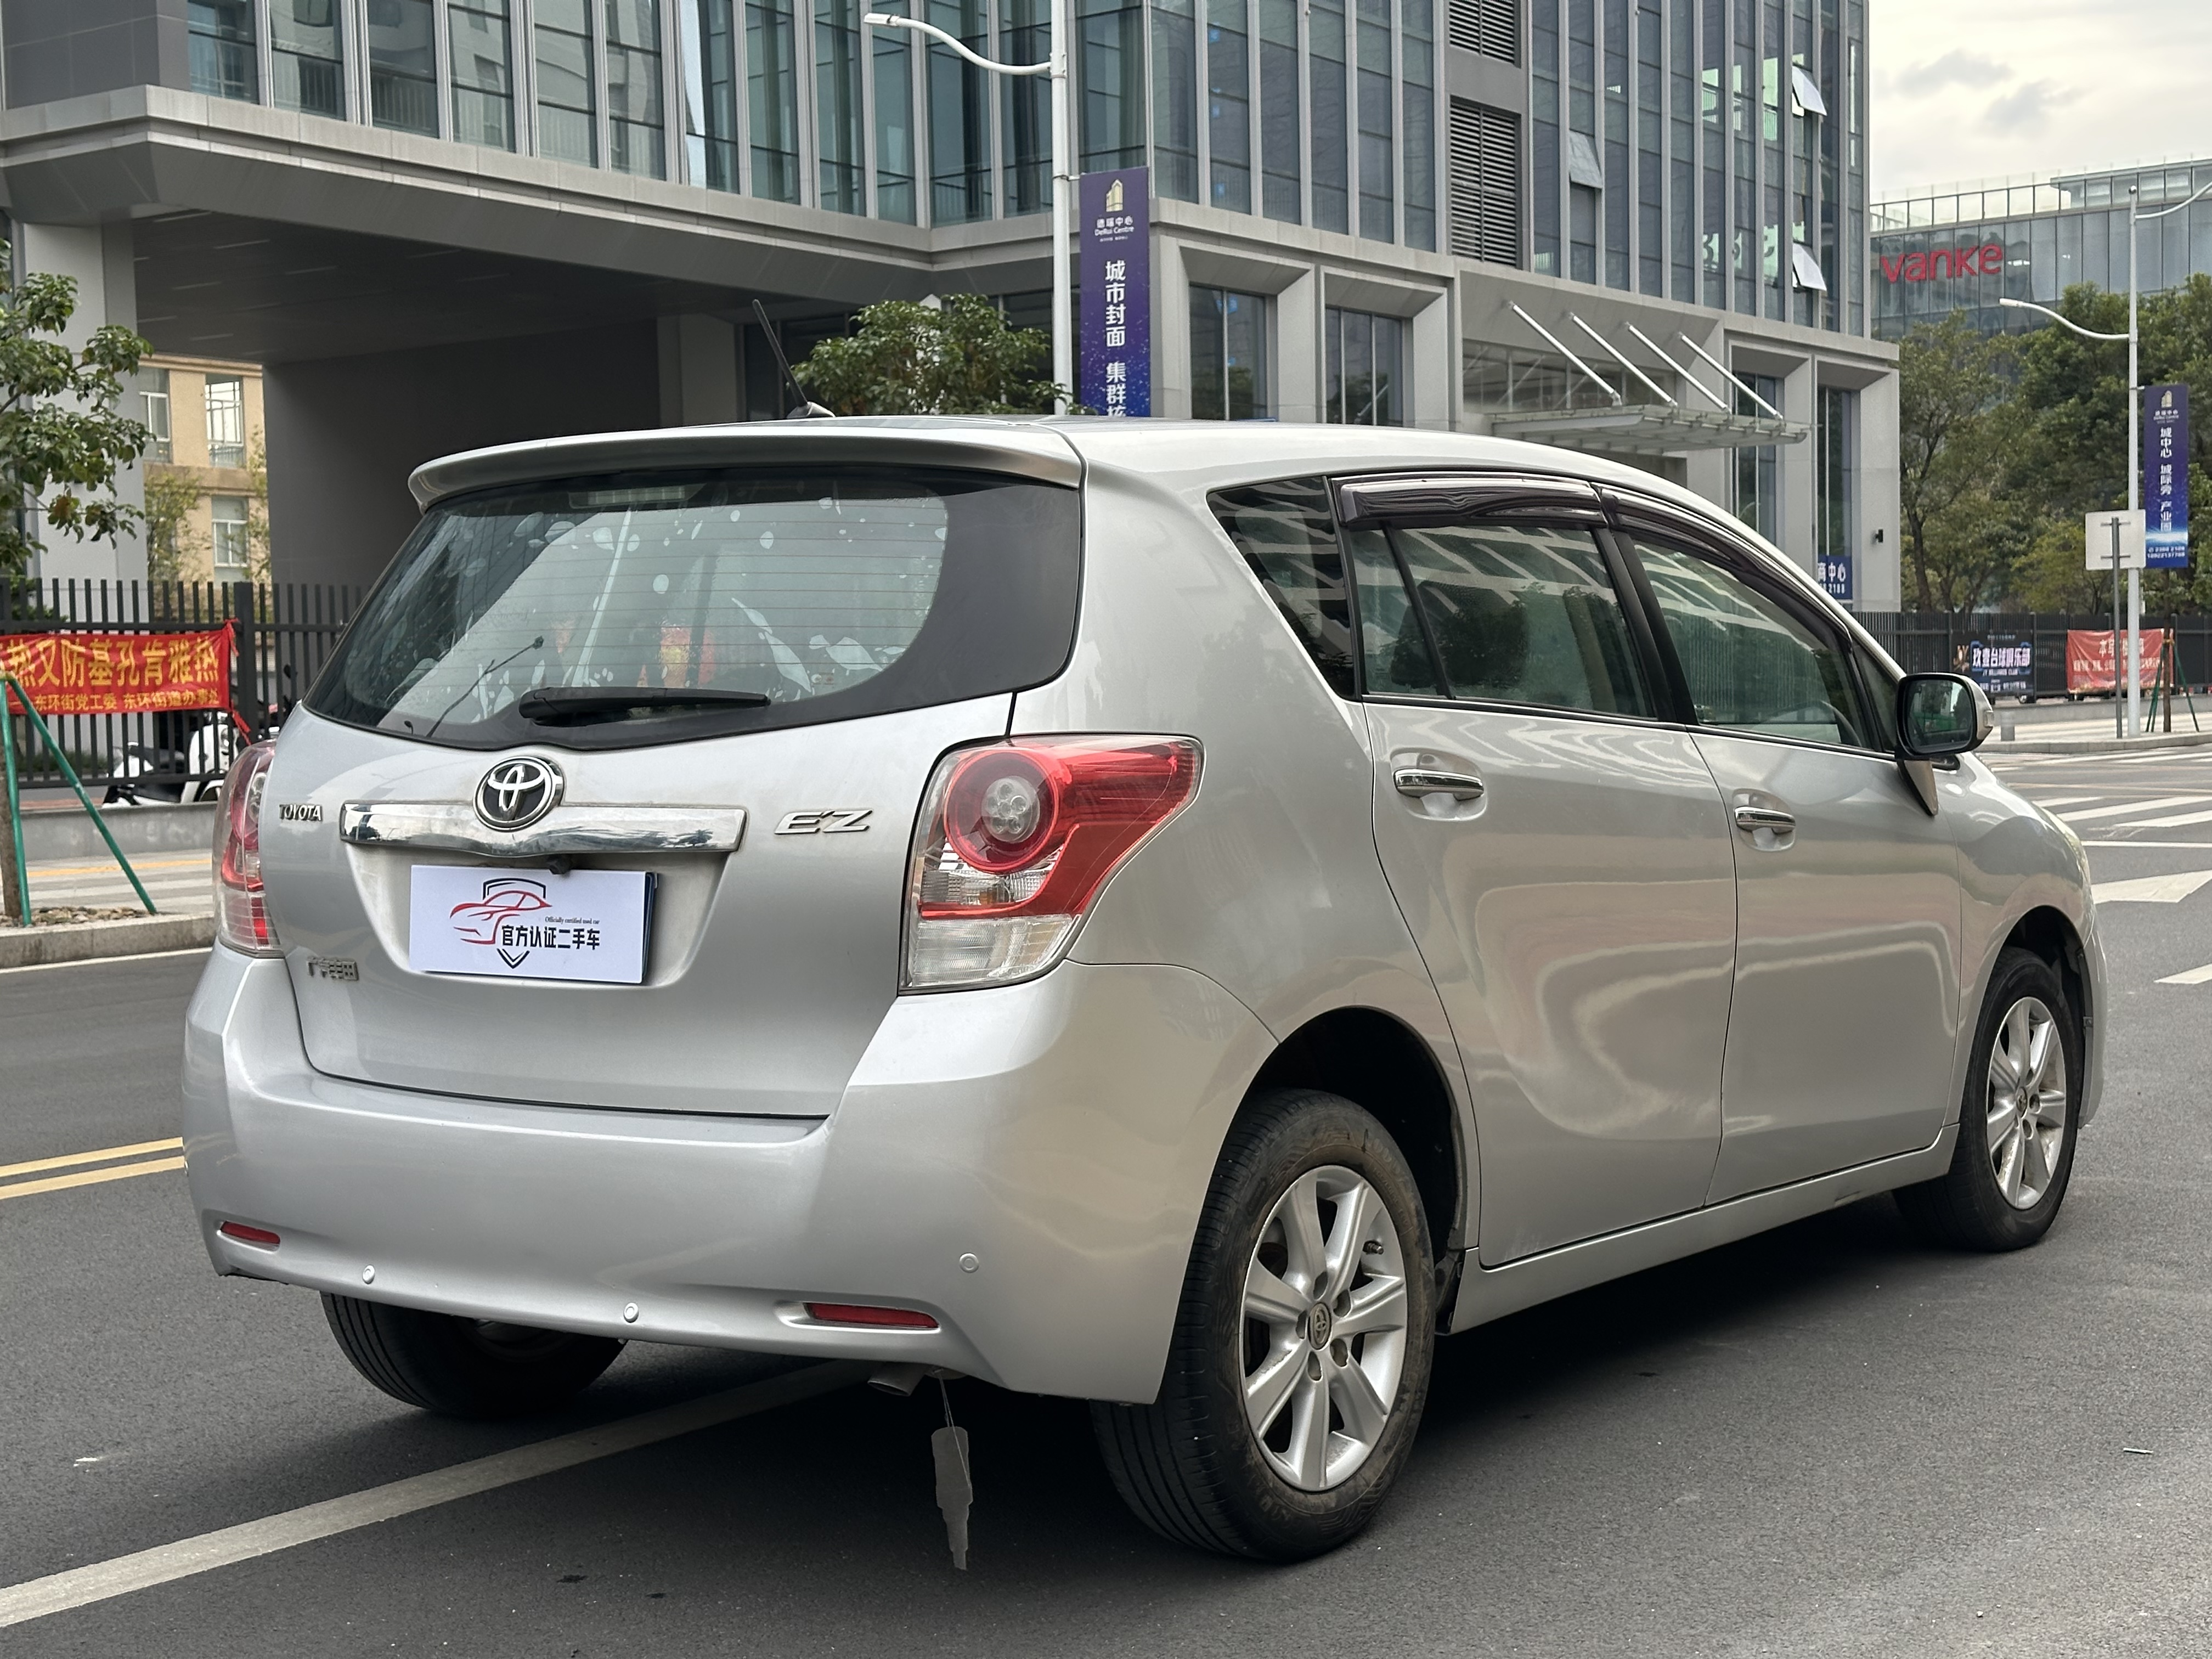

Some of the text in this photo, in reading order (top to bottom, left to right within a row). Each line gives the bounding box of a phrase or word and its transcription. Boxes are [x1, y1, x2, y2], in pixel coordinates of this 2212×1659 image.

[1105, 260, 1126, 347] 城市封面
[0, 636, 219, 687] 热又防基孔肯雅热
[34, 693, 117, 711] 东环街党工委
[279, 804, 323, 821] TOYOTA
[545, 916, 564, 924] Officially
[501, 924, 600, 950] 官方认证二手车
